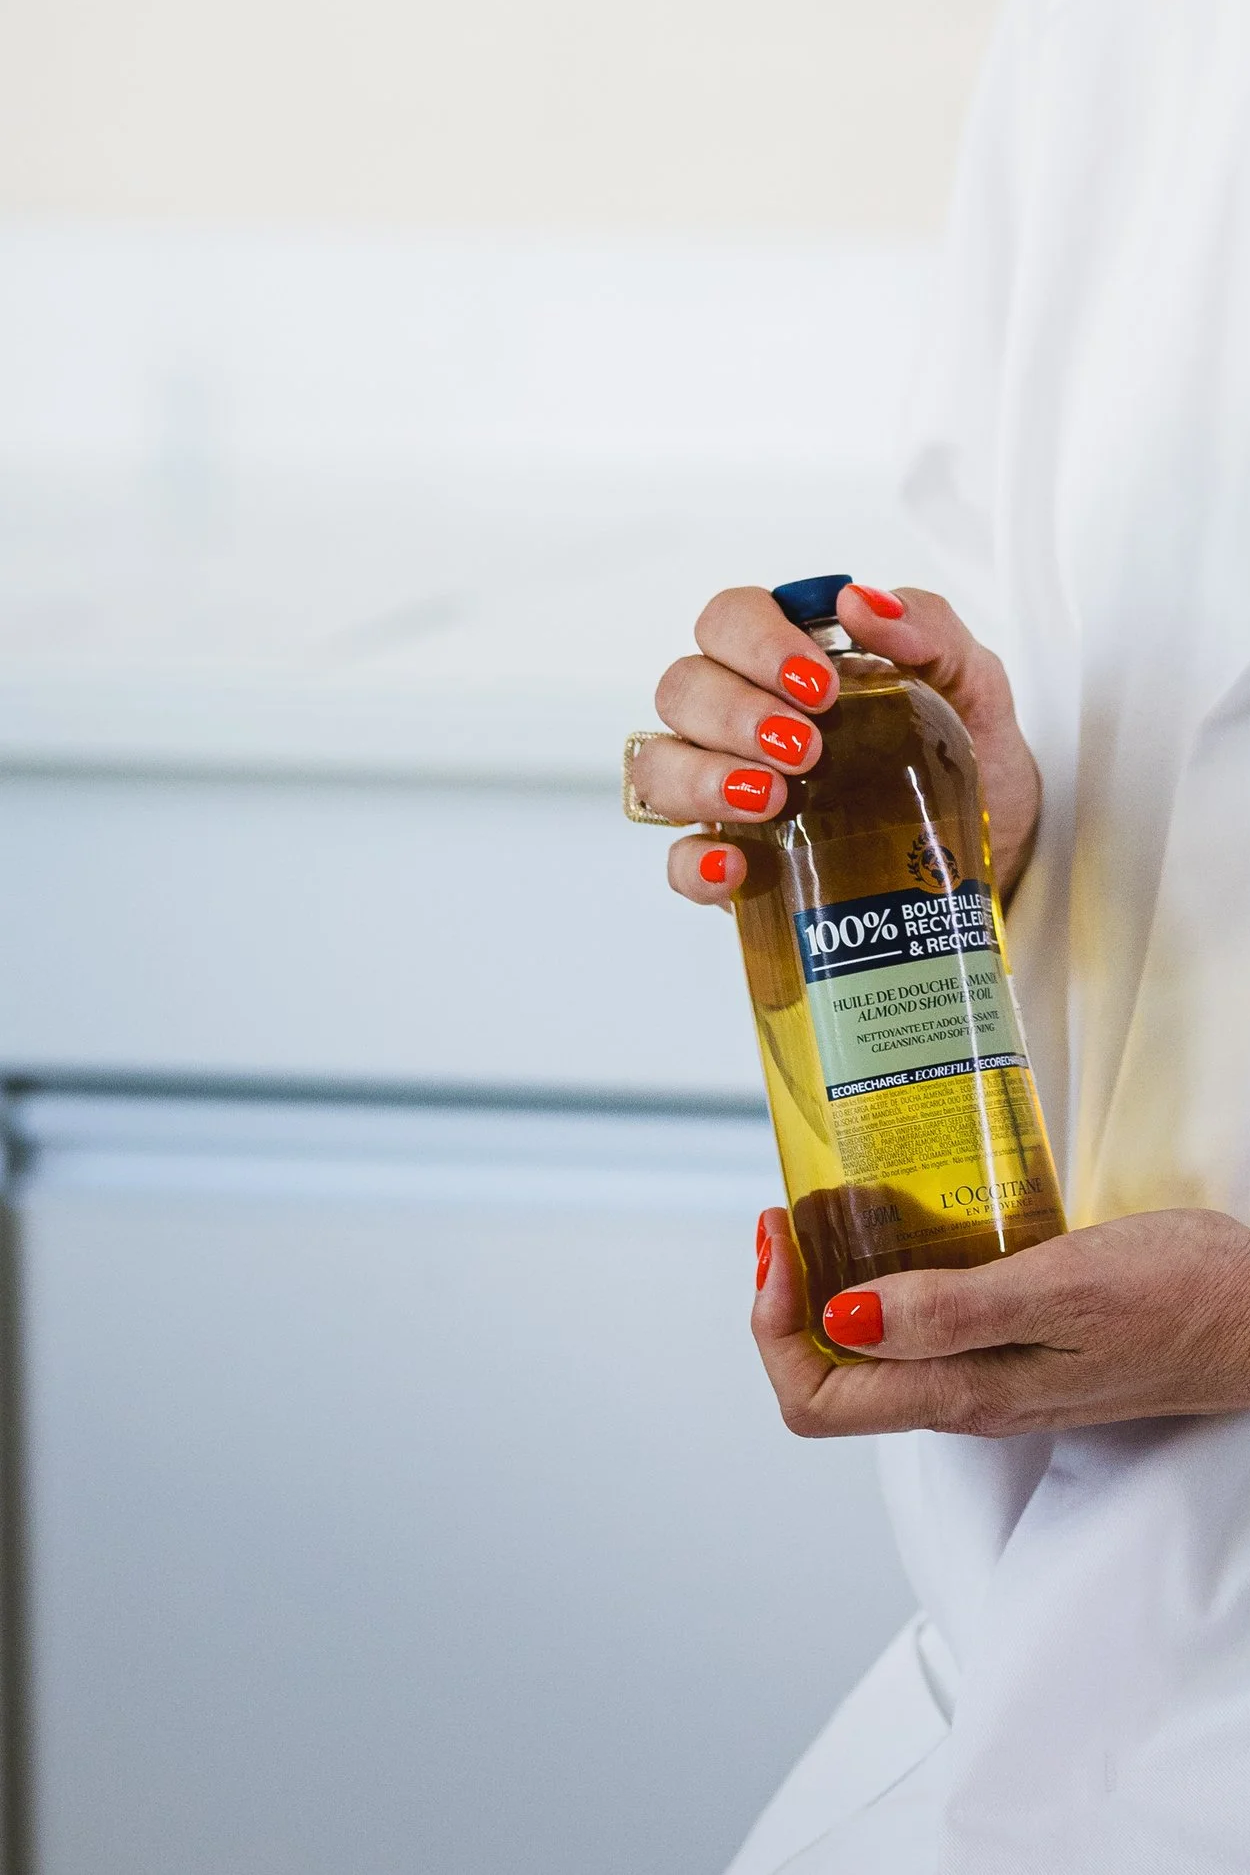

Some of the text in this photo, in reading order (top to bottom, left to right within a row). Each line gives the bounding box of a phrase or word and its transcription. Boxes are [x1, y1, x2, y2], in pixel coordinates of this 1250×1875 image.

[805, 909, 898, 957] 100%
[909, 931, 990, 956] & RECYCLA
[833, 993, 875, 1012] HUILE
[876, 988, 897, 1003] DE
[897, 977, 960, 999] DOUCHE
[858, 987, 993, 1022] ALMOND SHOWER OIL
[856, 1010, 999, 1044] NETTOYANTE ET ADOUCSSANTE
[871, 1023, 995, 1053] CLEANSING AND SOFTNING
[831, 1073, 909, 1099] ECORECHARGE
[915, 1061, 973, 1081] ECOREFILL
[966, 1198, 1033, 1216] EN POVENCE
